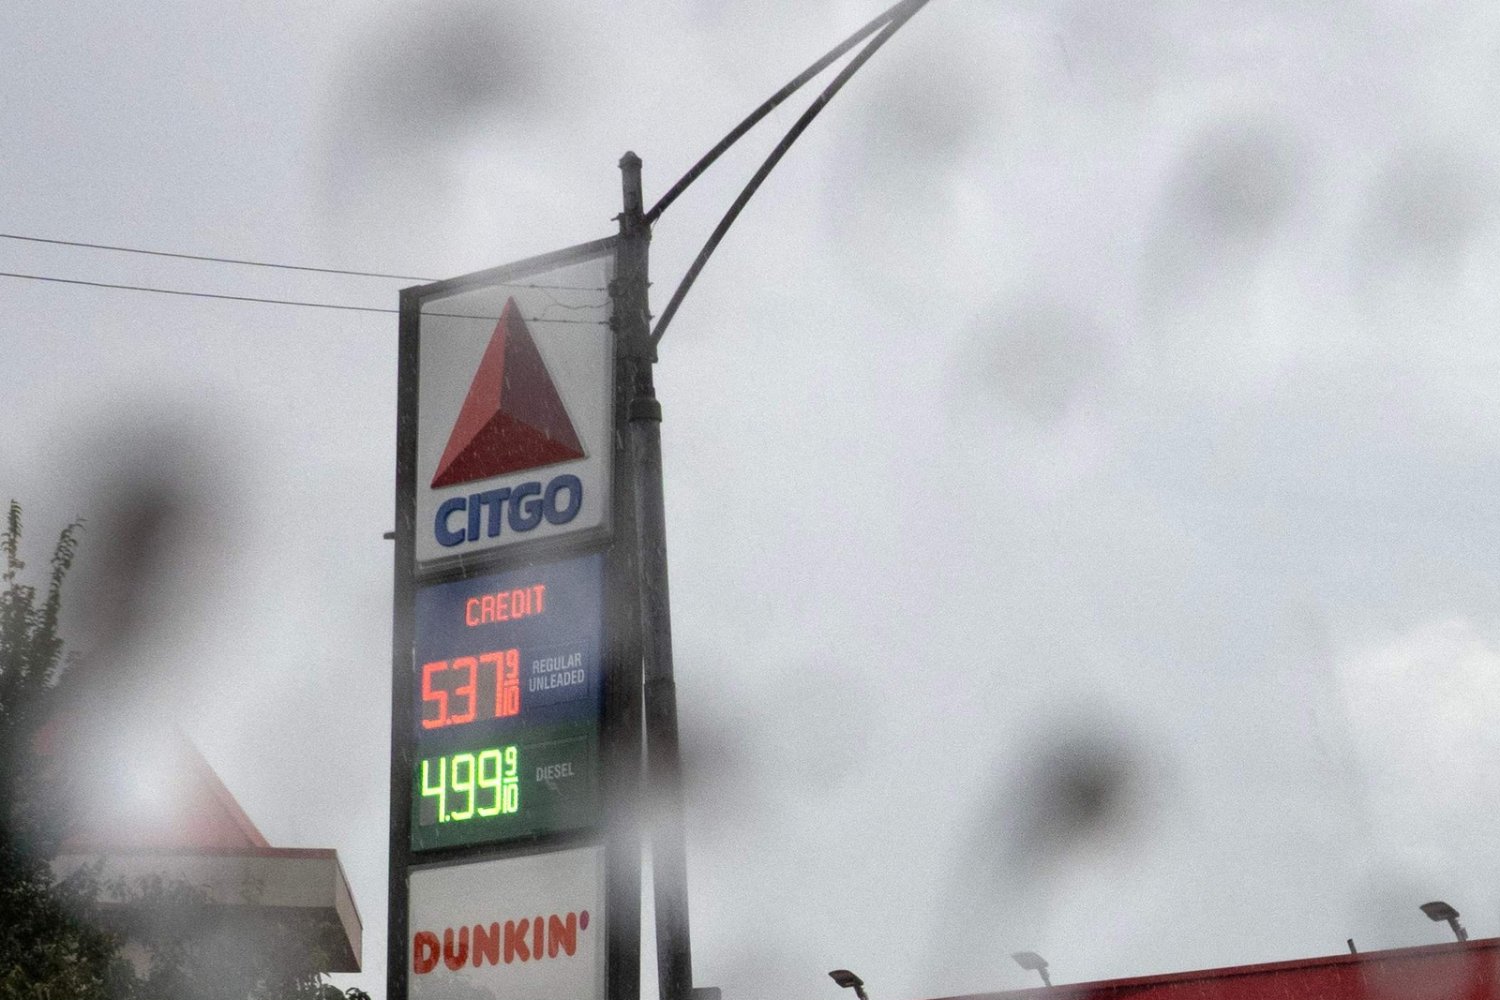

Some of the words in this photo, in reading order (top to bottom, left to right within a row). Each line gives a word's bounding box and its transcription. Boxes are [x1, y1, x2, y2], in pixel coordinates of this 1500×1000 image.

[434, 474, 583, 547] CITGO
[465, 584, 546, 628] CREDIT
[532, 652, 582, 674] REGULAR
[528, 669, 585, 693] UNLEADED
[535, 762, 575, 782] DIESEL
[413, 910, 590, 975] DUNKIN'
